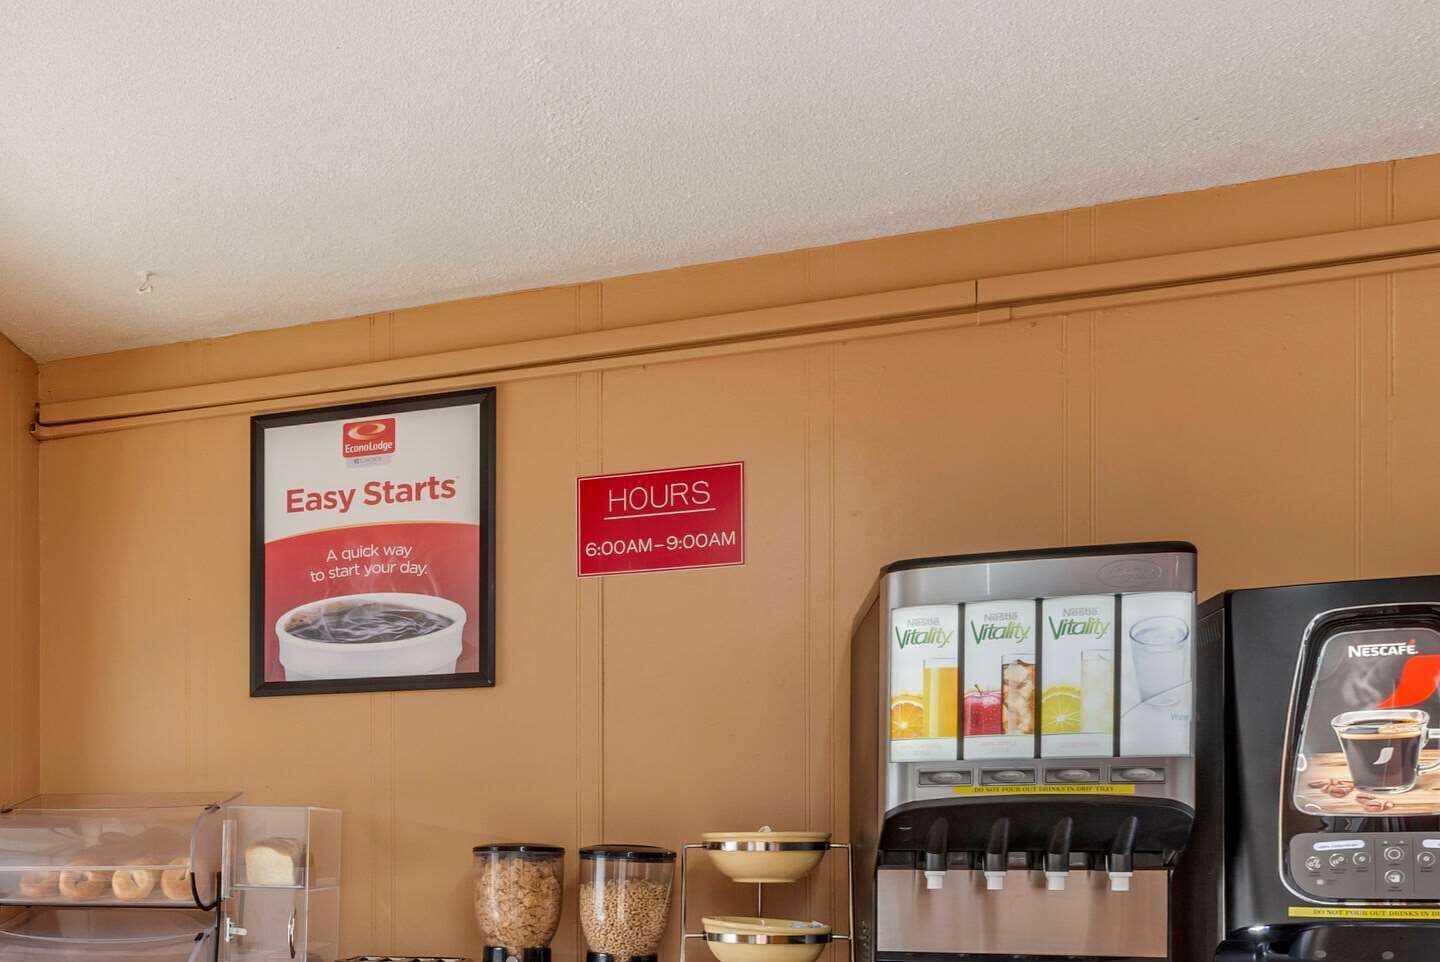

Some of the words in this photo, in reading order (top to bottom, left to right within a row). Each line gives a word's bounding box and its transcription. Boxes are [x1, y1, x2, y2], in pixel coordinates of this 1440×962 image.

[286, 488, 357, 513] Easy
[363, 475, 457, 506] Starts
[608, 480, 711, 513] HOURS
[326, 549, 338, 562] A
[341, 544, 379, 562] quick
[383, 546, 413, 559] way
[585, 530, 736, 557] 6:00AM-9:00AM
[310, 570, 325, 583] to
[328, 564, 360, 580] start
[364, 563, 397, 577] your
[399, 561, 428, 577] day.
[895, 625, 954, 650] Vitality
[970, 620, 1031, 645] Vitality
[1048, 615, 1111, 640] Vitality
